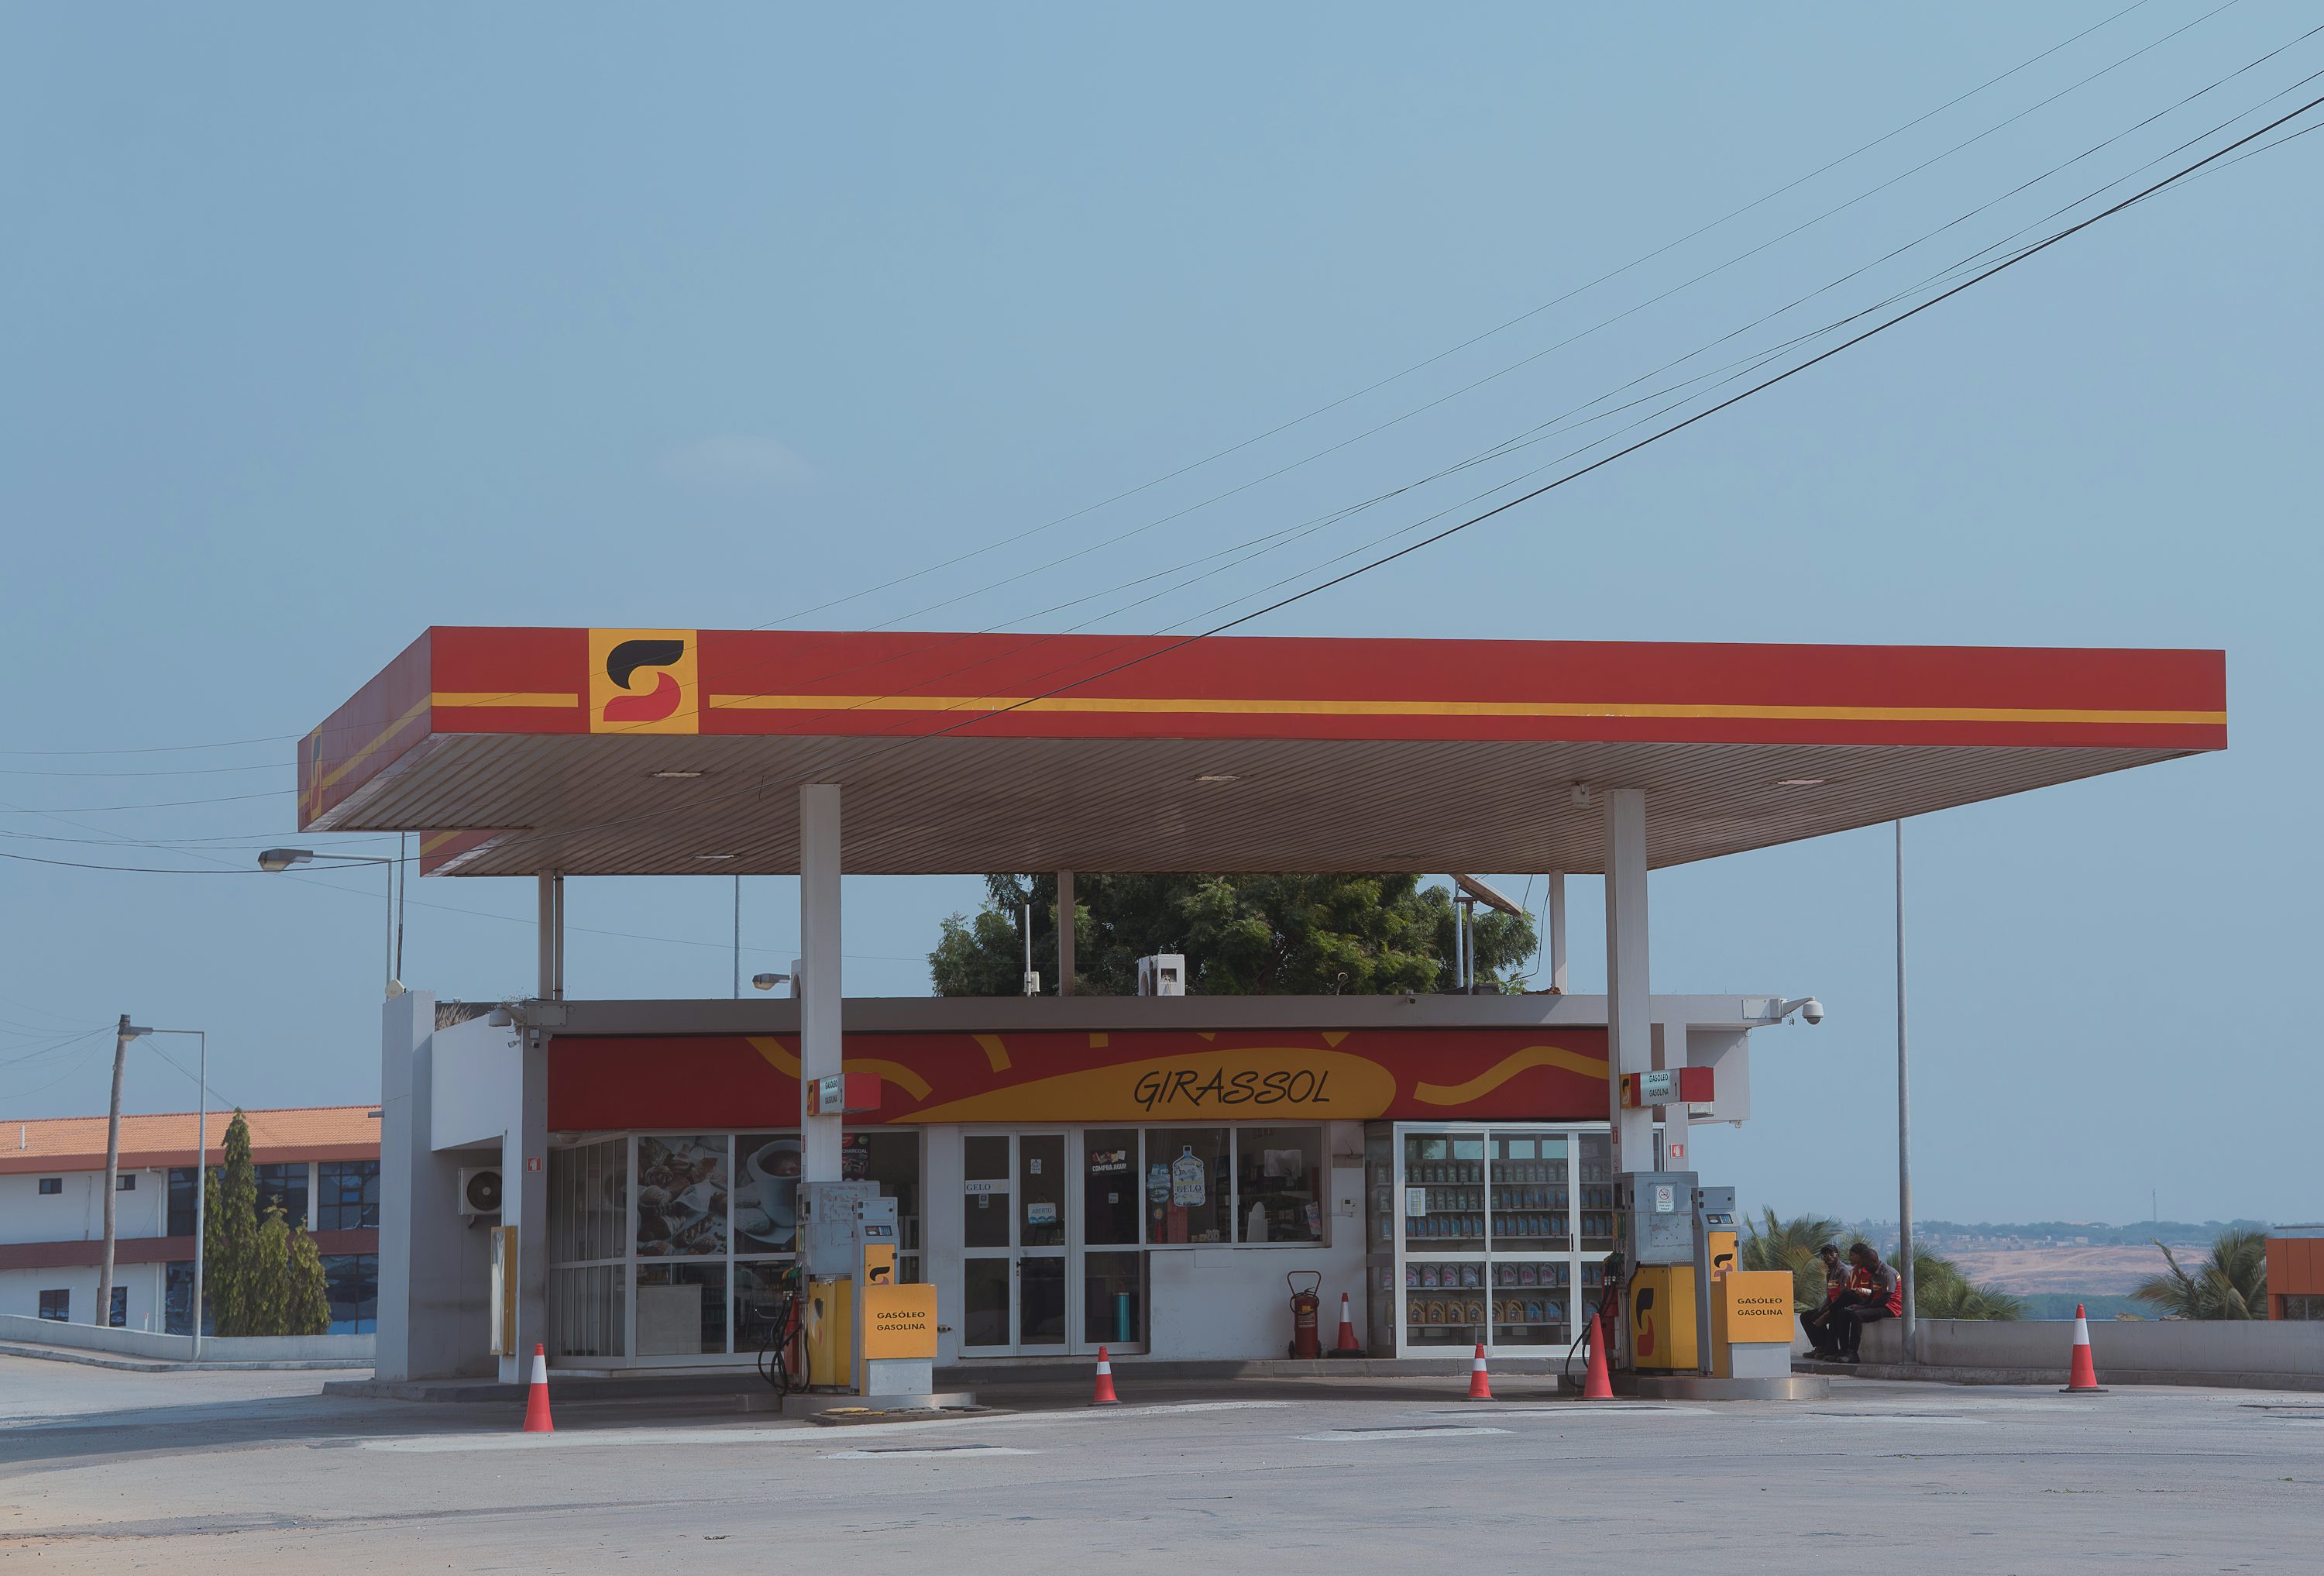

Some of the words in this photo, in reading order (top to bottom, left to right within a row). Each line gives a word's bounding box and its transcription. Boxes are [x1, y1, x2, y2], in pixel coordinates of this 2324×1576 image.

[1648, 1072, 1669, 1082] GASÓLEO
[824, 1078, 838, 1089] GASÓLEO
[1133, 1065, 1330, 1112] GIRASSOL
[1648, 1087, 1669, 1097] GASOLINA
[1674, 1082, 1678, 1097] 1
[824, 1095, 837, 1104] GASOLINA
[1092, 1164, 1113, 1172] COMPRA
[966, 1183, 991, 1192] GELO
[1177, 1185, 1202, 1193] GELO
[877, 1310, 926, 1319] GASÓLEO
